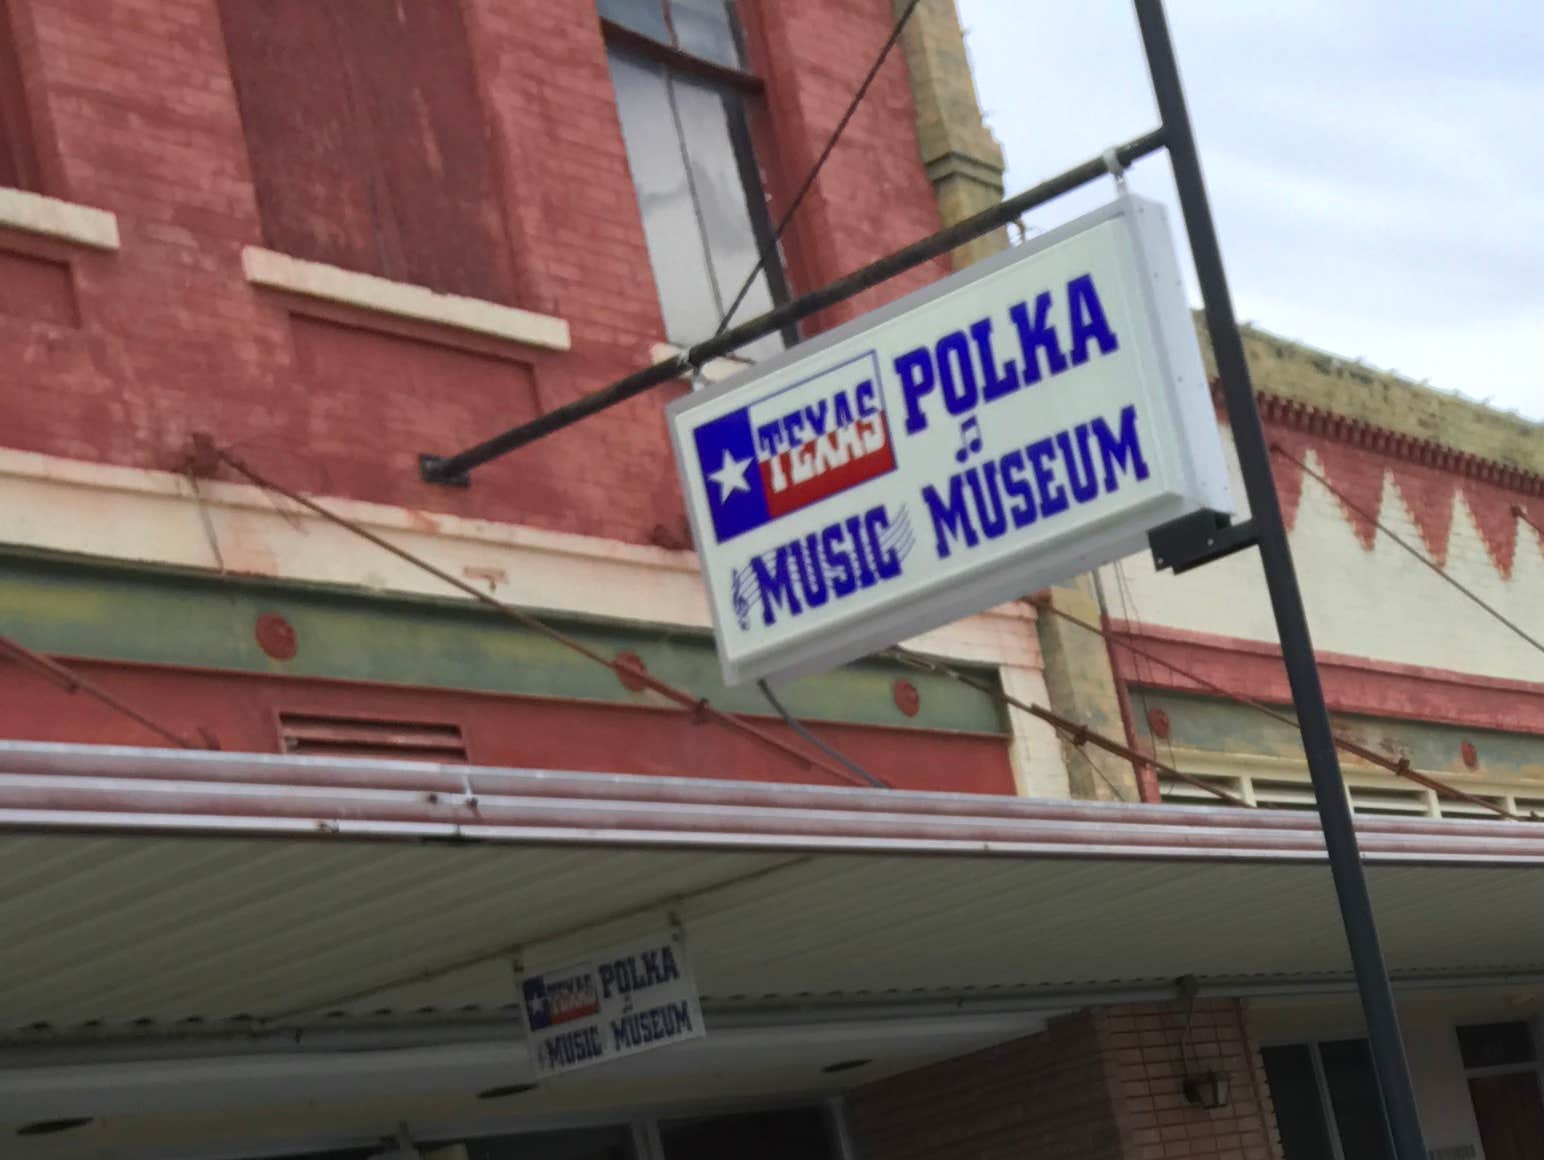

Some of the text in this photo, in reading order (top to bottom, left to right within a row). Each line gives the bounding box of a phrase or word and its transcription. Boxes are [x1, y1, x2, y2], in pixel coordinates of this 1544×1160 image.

[756, 273, 1119, 494] TEXAS POLKA
[750, 404, 1150, 627] MUSIC MUSEUM
[547, 1002, 692, 1068] MUSIC MUSEUM
[599, 946, 679, 998] POLKA
